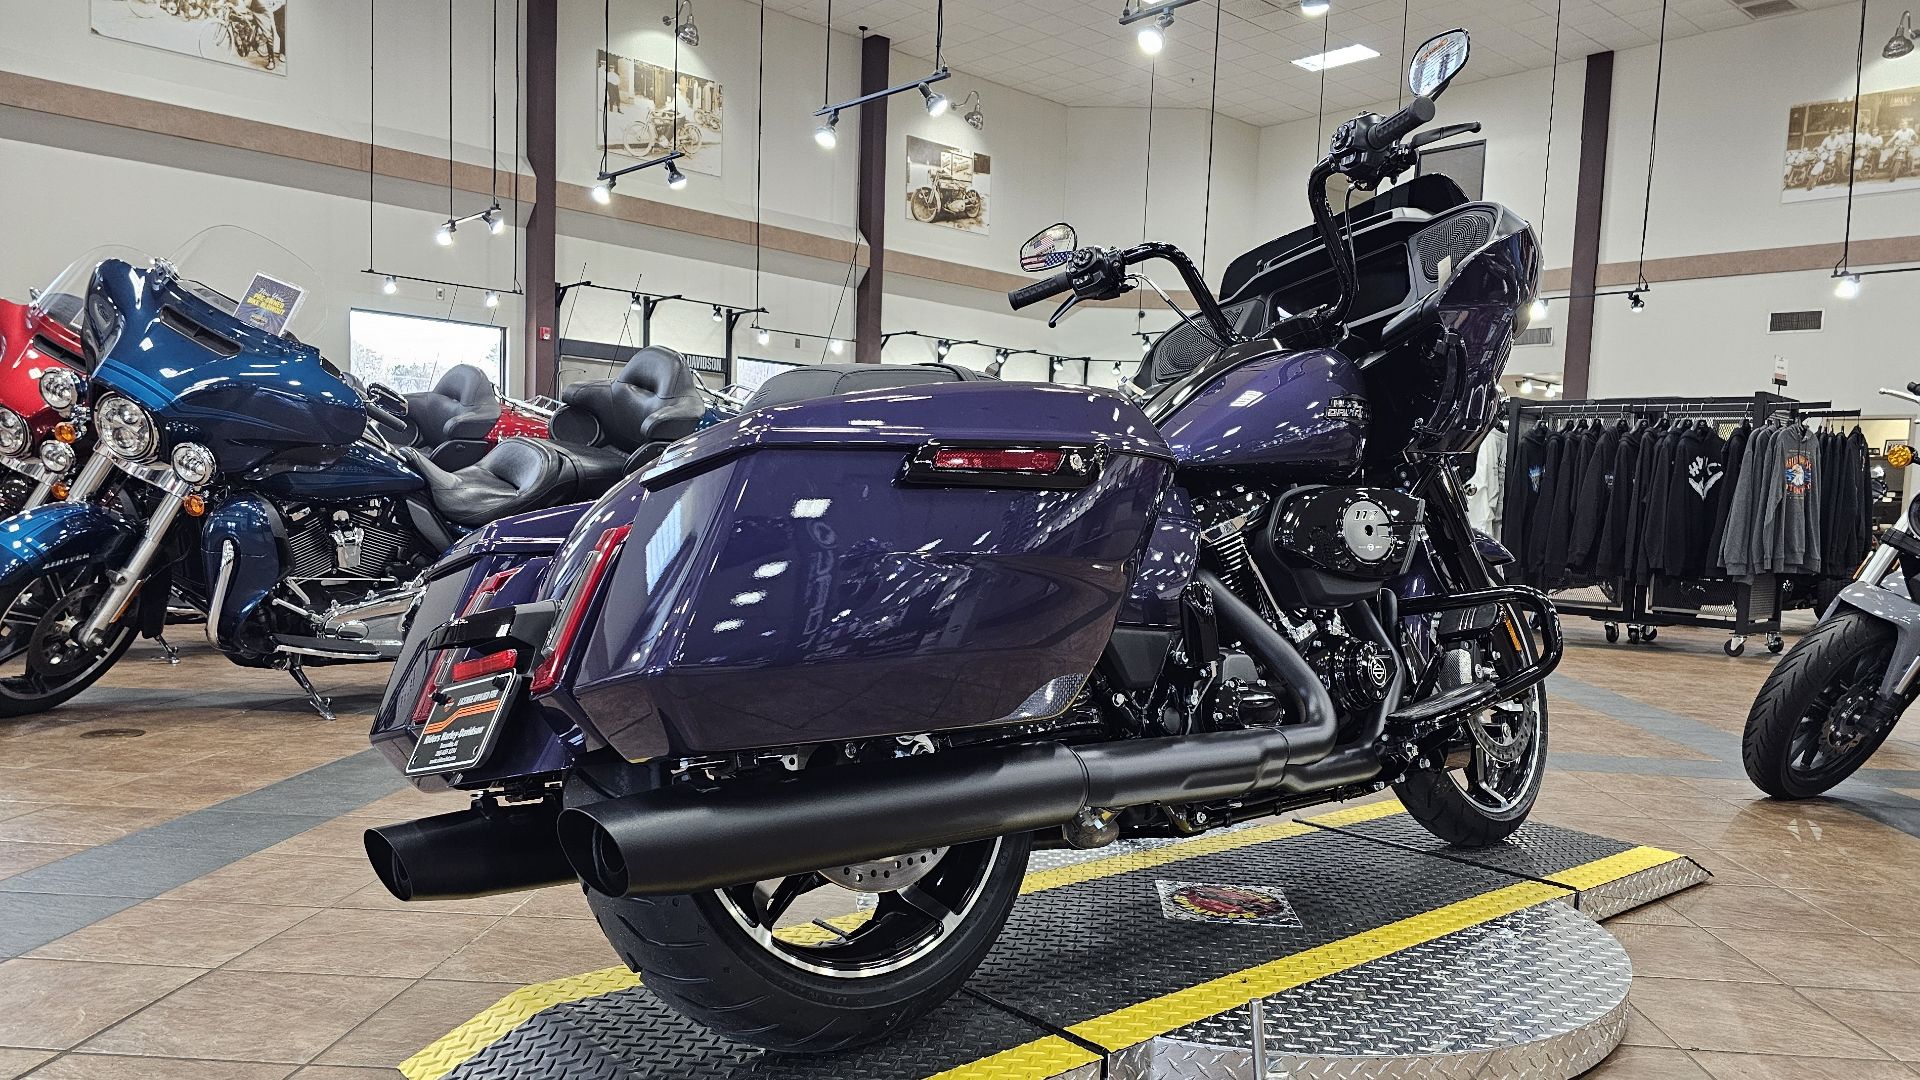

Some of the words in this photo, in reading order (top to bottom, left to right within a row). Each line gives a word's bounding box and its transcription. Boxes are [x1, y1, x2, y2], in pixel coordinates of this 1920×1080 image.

[253, 293, 285, 308] PRE-OWNED
[687, 355, 722, 371] DAVIDSON
[1355, 510, 1379, 520] 117
